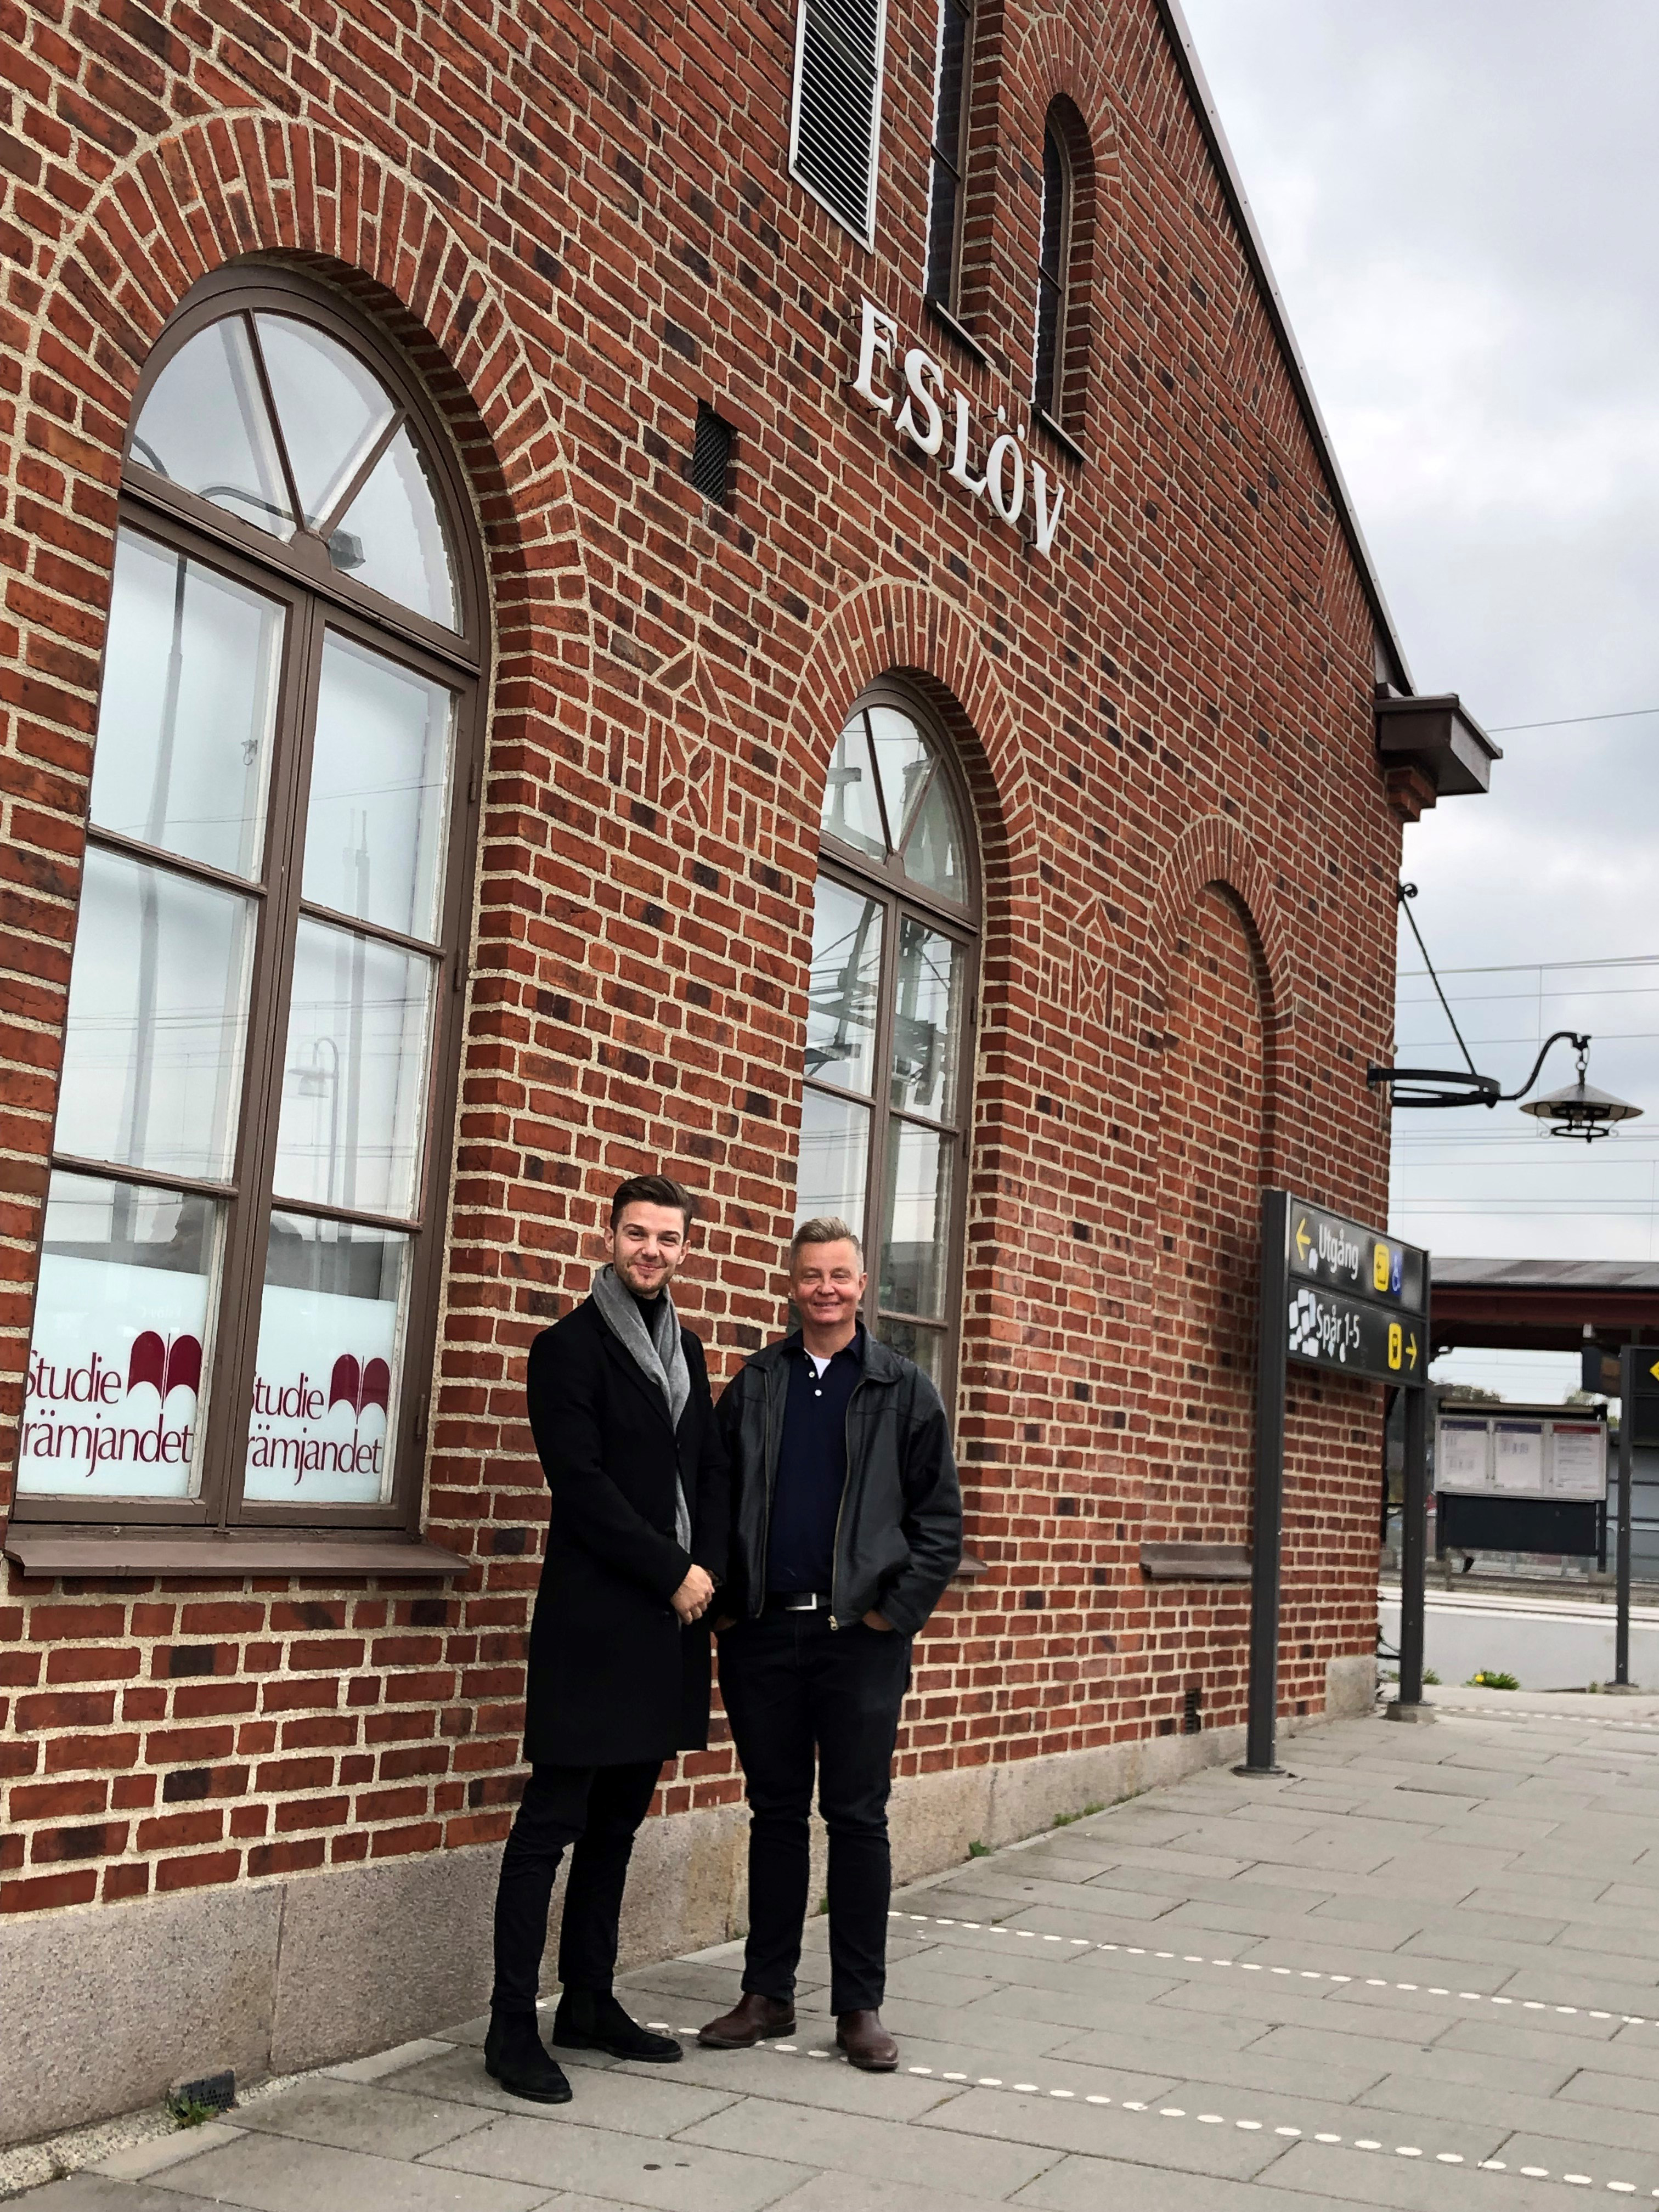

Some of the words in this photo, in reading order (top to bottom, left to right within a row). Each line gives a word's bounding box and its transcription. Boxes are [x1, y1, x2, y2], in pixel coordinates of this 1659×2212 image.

[853, 294, 1065, 558] ESLÖV
[1318, 1224, 1359, 1280] Utgång
[1317, 1304, 1343, 1350] Spår
[1344, 1312, 1360, 1349] 1-5
[253, 1373, 324, 1419] tudie
[22, 1409, 193, 1477] rämjandet
